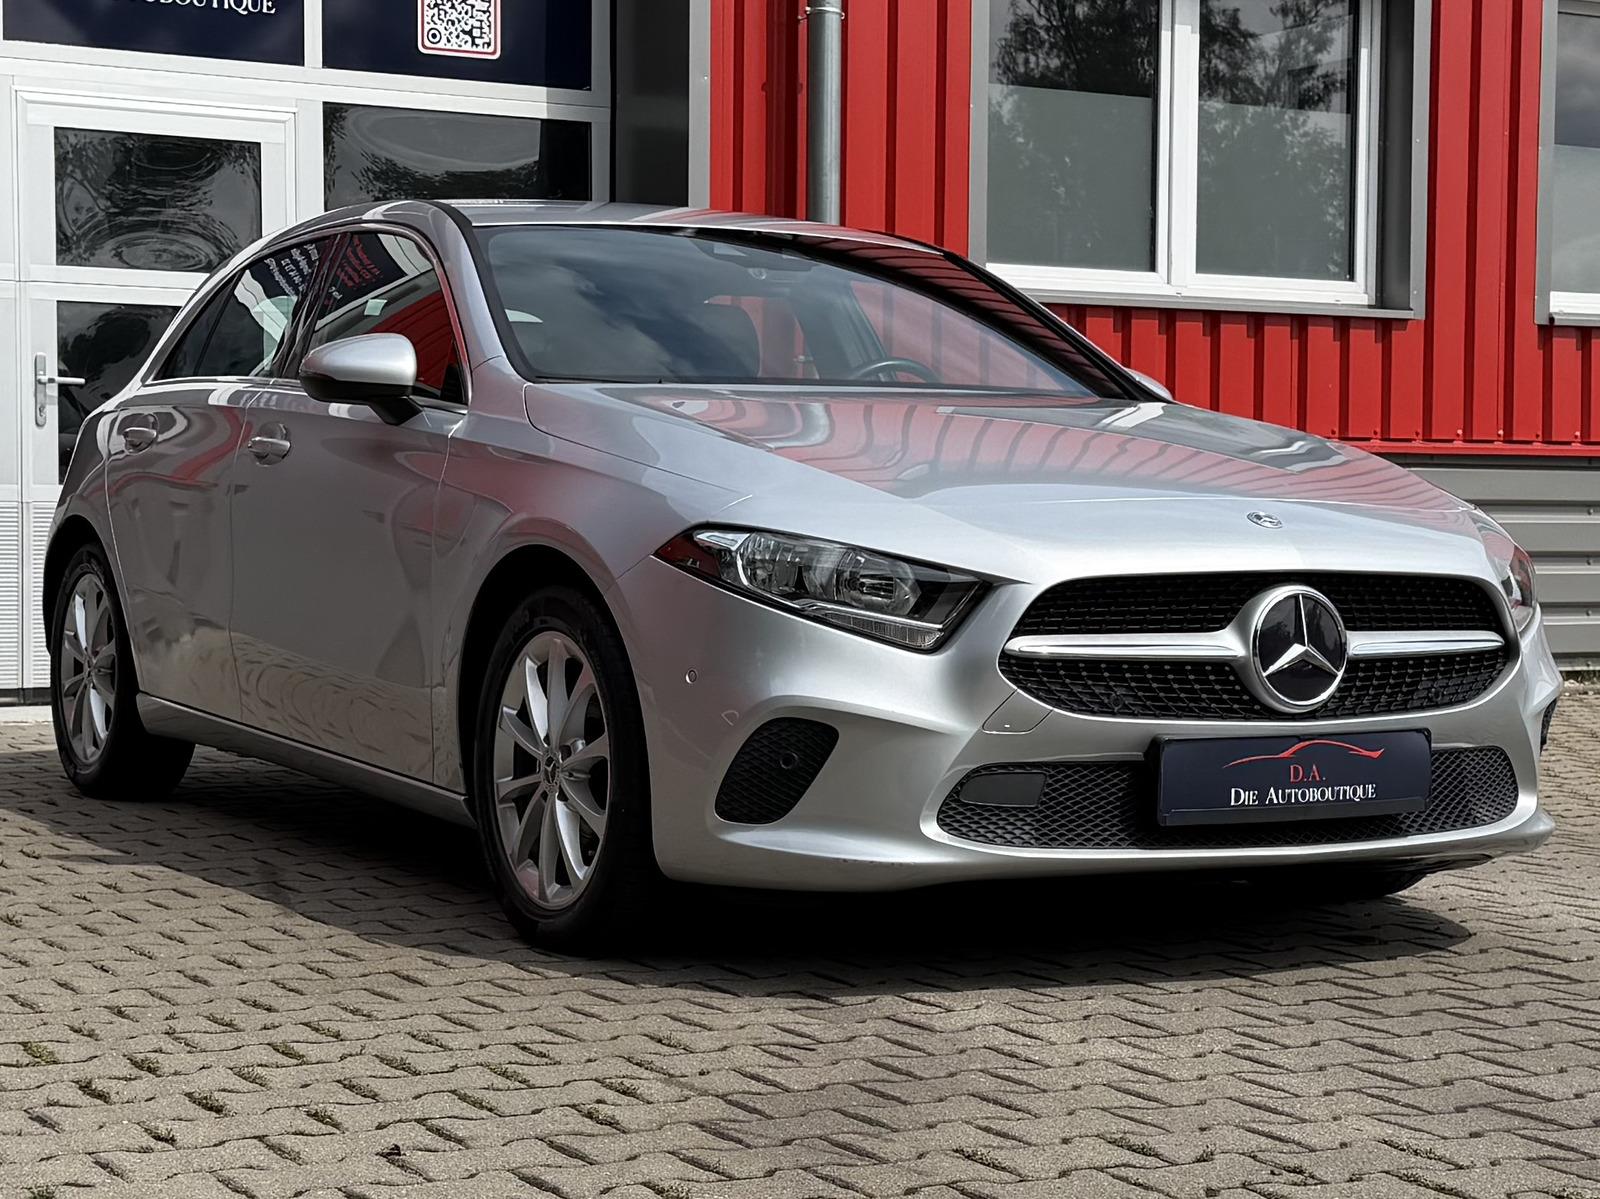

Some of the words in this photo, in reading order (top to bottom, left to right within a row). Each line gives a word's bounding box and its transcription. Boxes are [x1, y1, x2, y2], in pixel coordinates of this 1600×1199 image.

[1290, 764, 1327, 783] D.A.
[1230, 787, 1259, 806] DIE
[1265, 784, 1376, 804] AUTOBOUTIQUE
